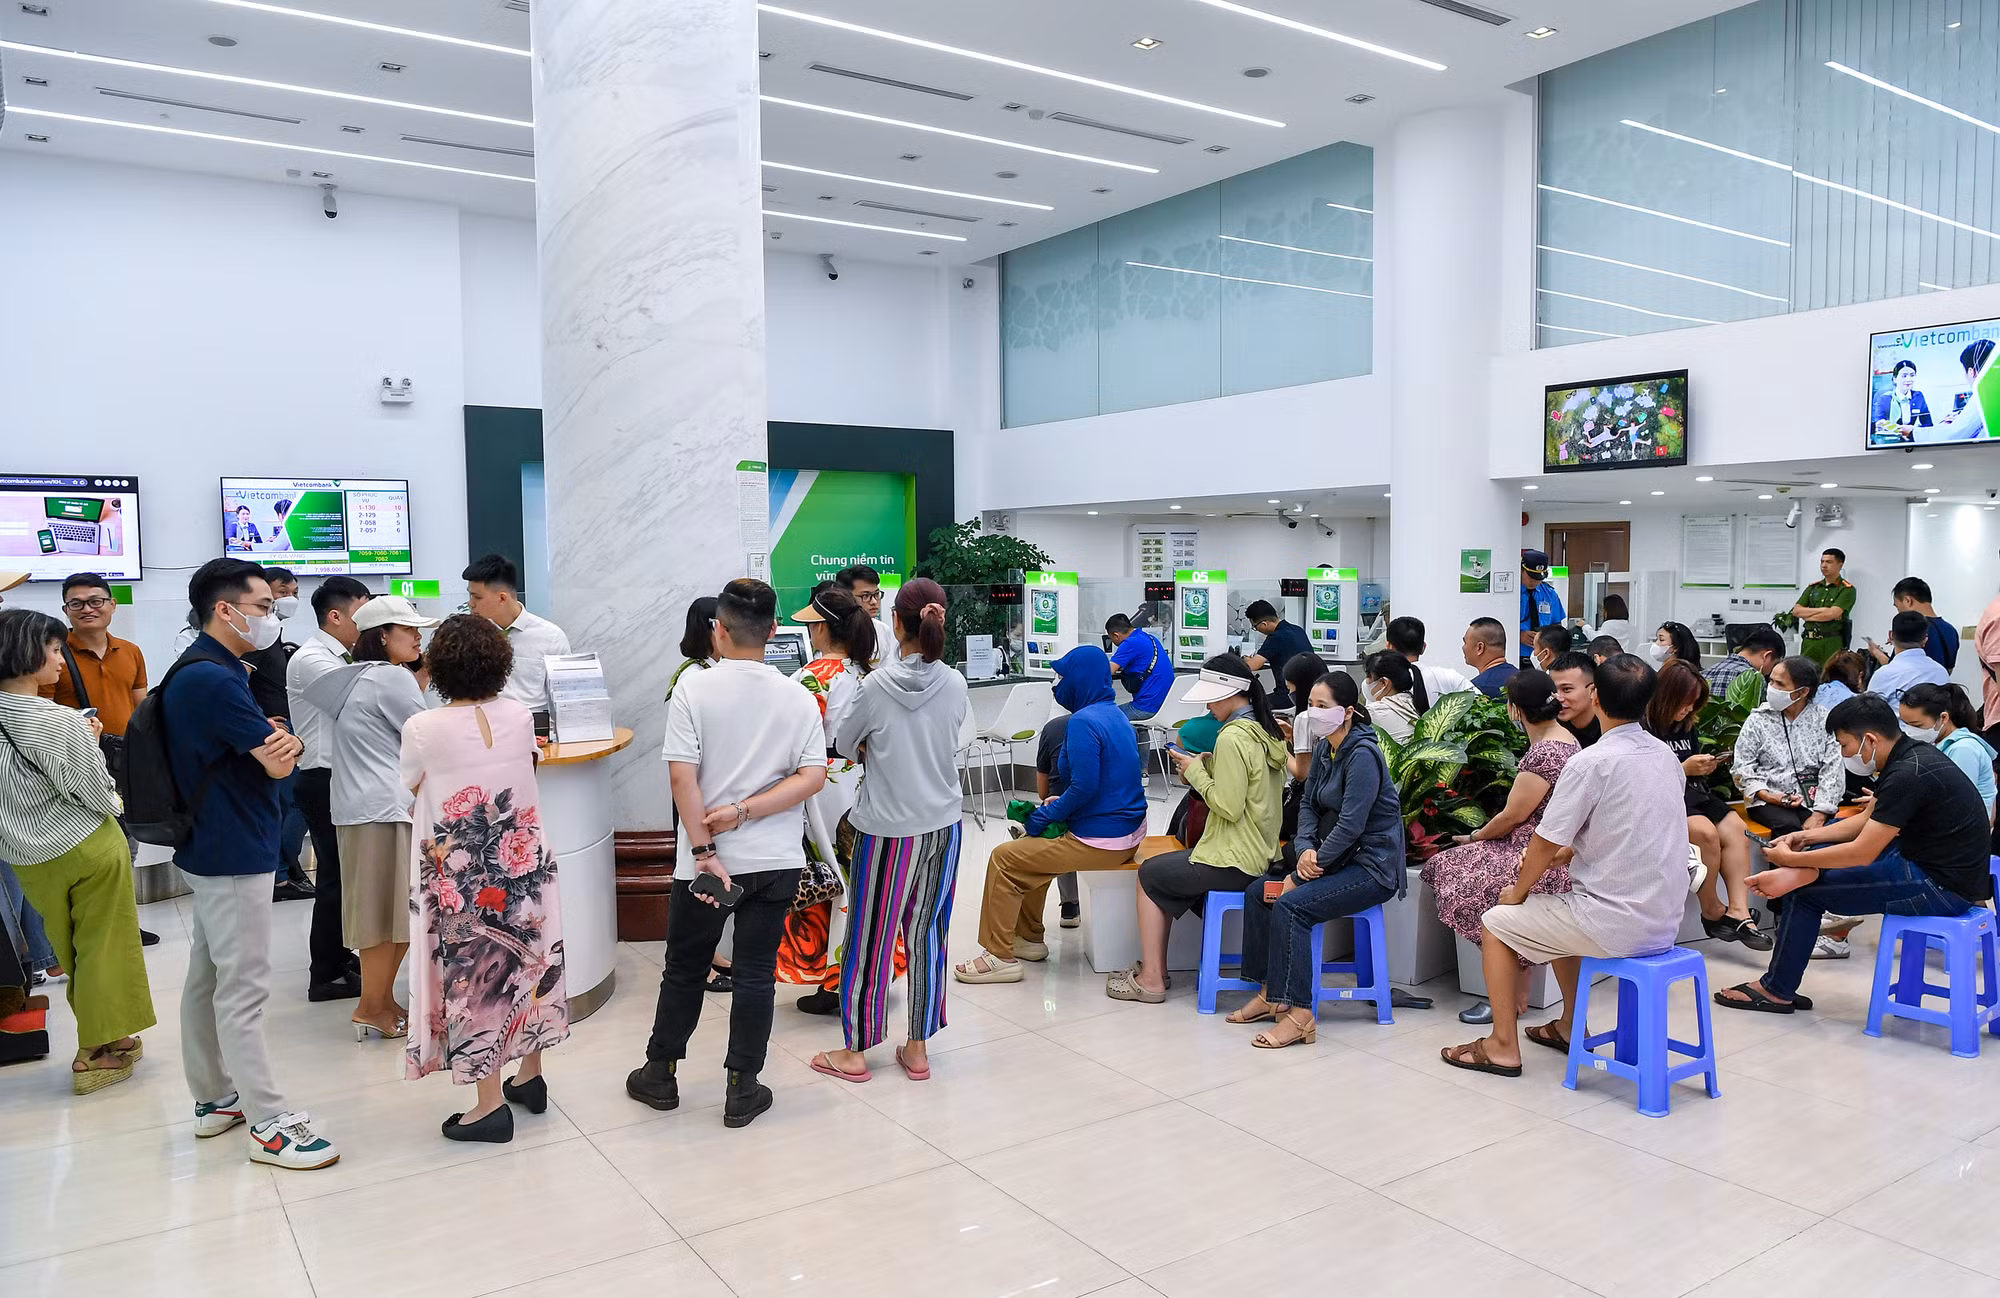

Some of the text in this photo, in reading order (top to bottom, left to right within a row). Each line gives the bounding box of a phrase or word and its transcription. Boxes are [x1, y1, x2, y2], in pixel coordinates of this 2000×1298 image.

[811, 553, 895, 567] Chung niềm tin
[816, 570, 837, 581] vữn
[1040, 573, 1057, 585] 04
[1192, 571, 1209, 583] 05
[1322, 569, 1339, 580] 06
[401, 581, 415, 597] 01
